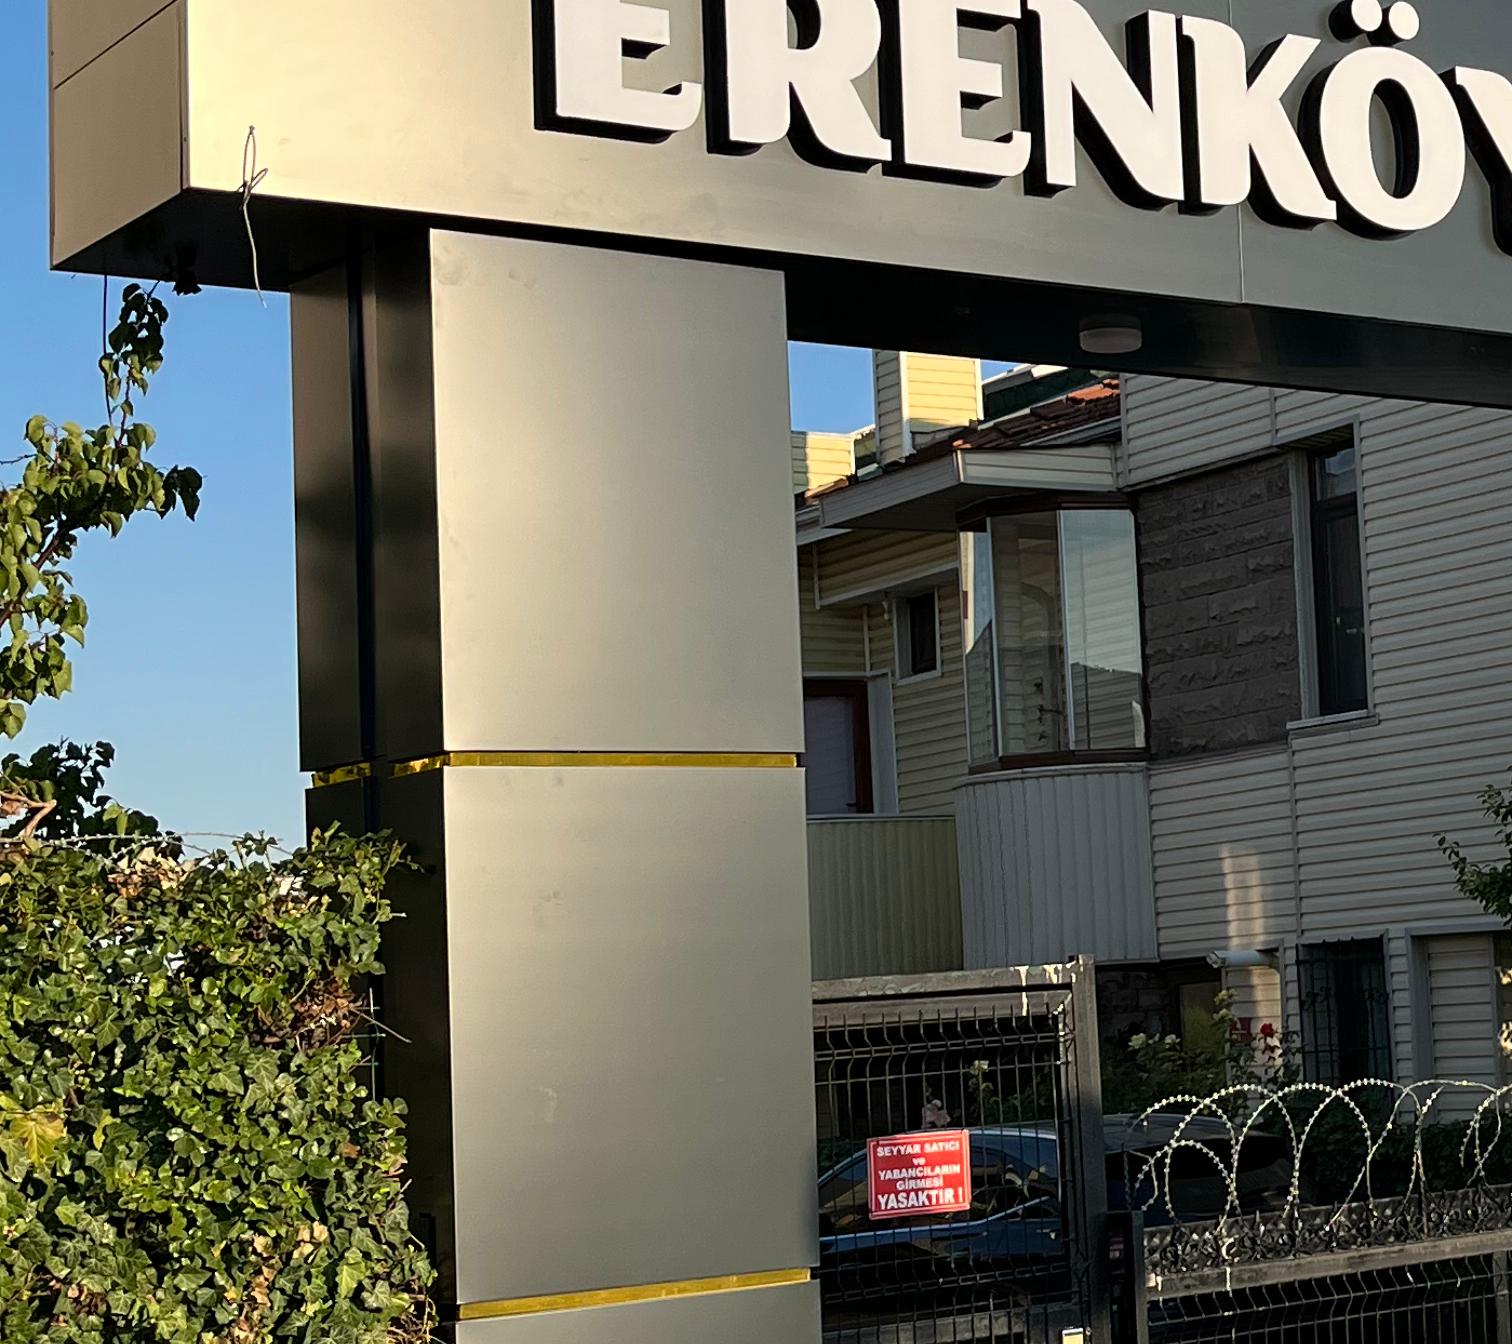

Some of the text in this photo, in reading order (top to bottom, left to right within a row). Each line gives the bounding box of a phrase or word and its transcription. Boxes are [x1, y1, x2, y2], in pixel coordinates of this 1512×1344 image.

[877, 1140, 960, 1157] SEYYAR SATICI
[878, 1164, 961, 1180] YABANCILARIN
[896, 1176, 944, 1191] GİRMESİ
[877, 1188, 956, 1210] YASAKTIR
